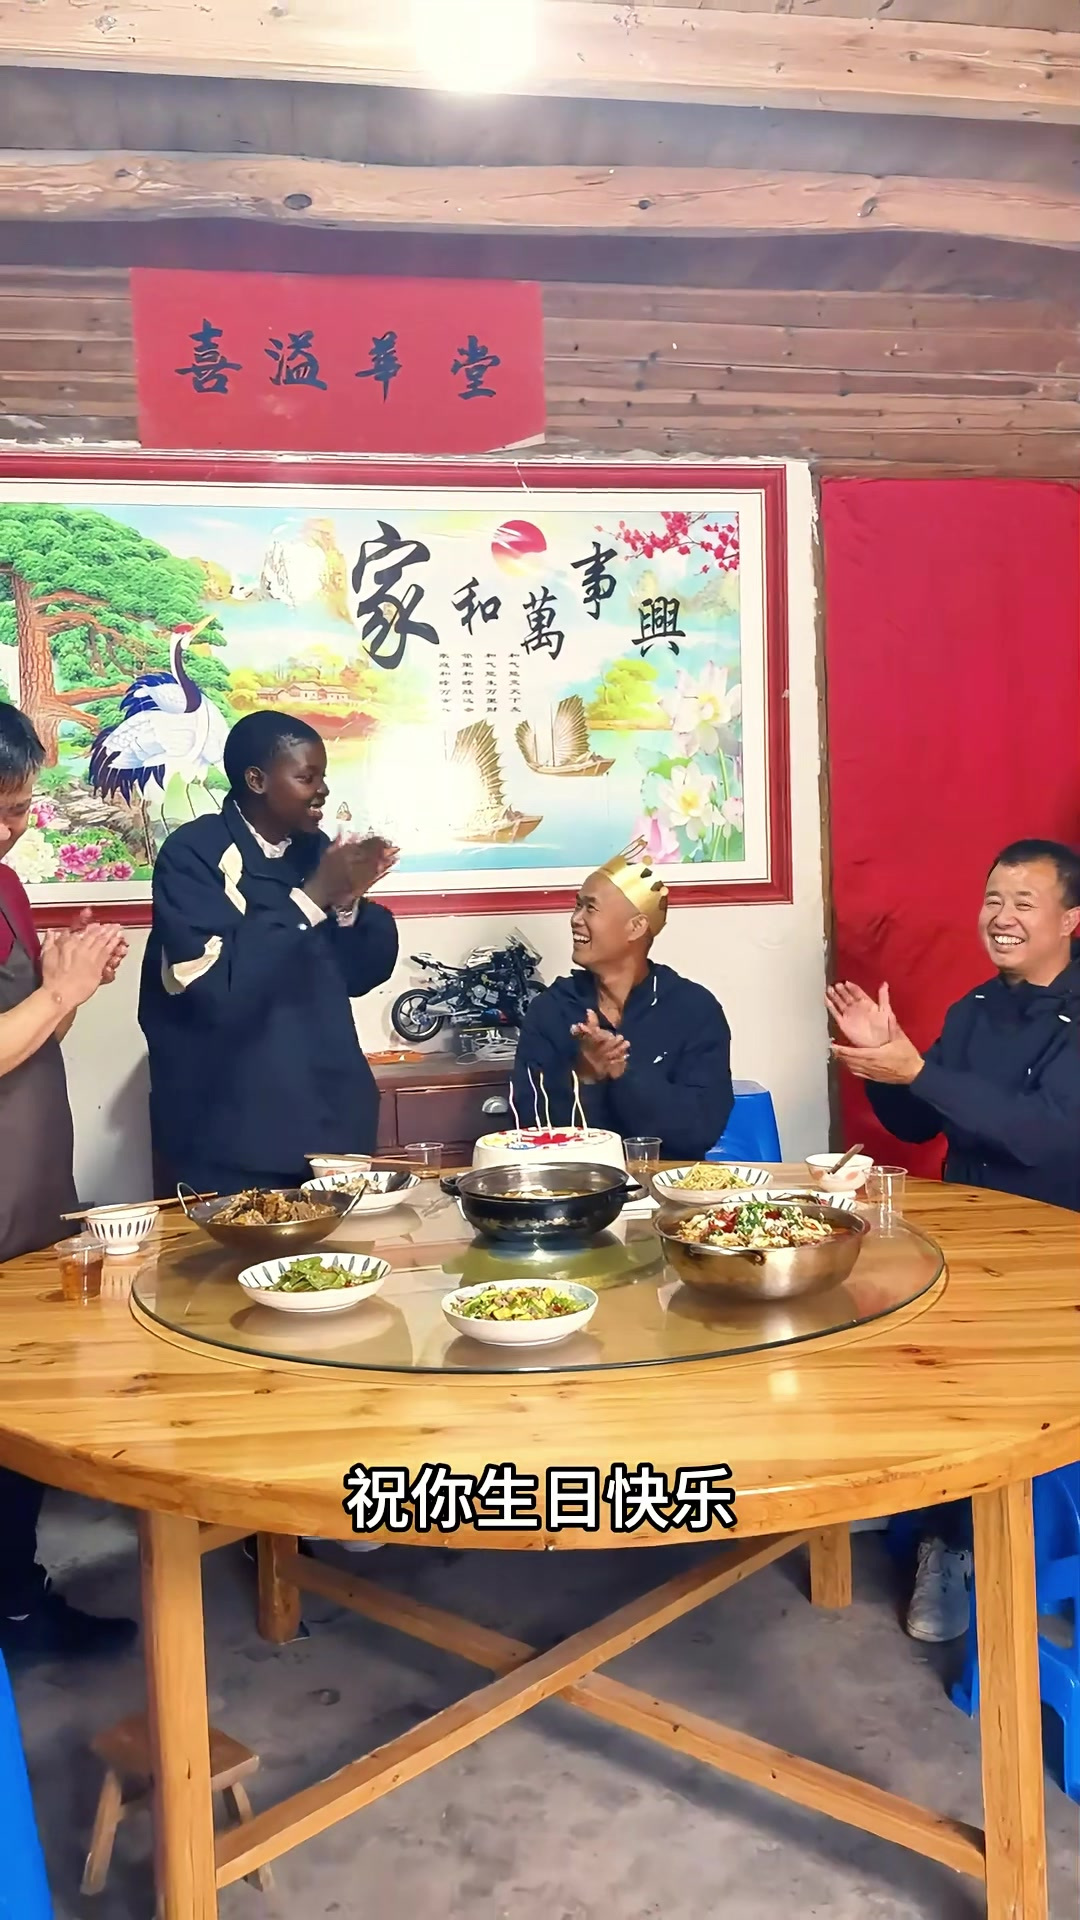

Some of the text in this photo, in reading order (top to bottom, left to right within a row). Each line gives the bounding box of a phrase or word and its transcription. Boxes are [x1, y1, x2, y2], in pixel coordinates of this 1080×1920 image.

[175, 318, 501, 402] 喜溢華堂
[351, 519, 686, 670] 家和萬事興
